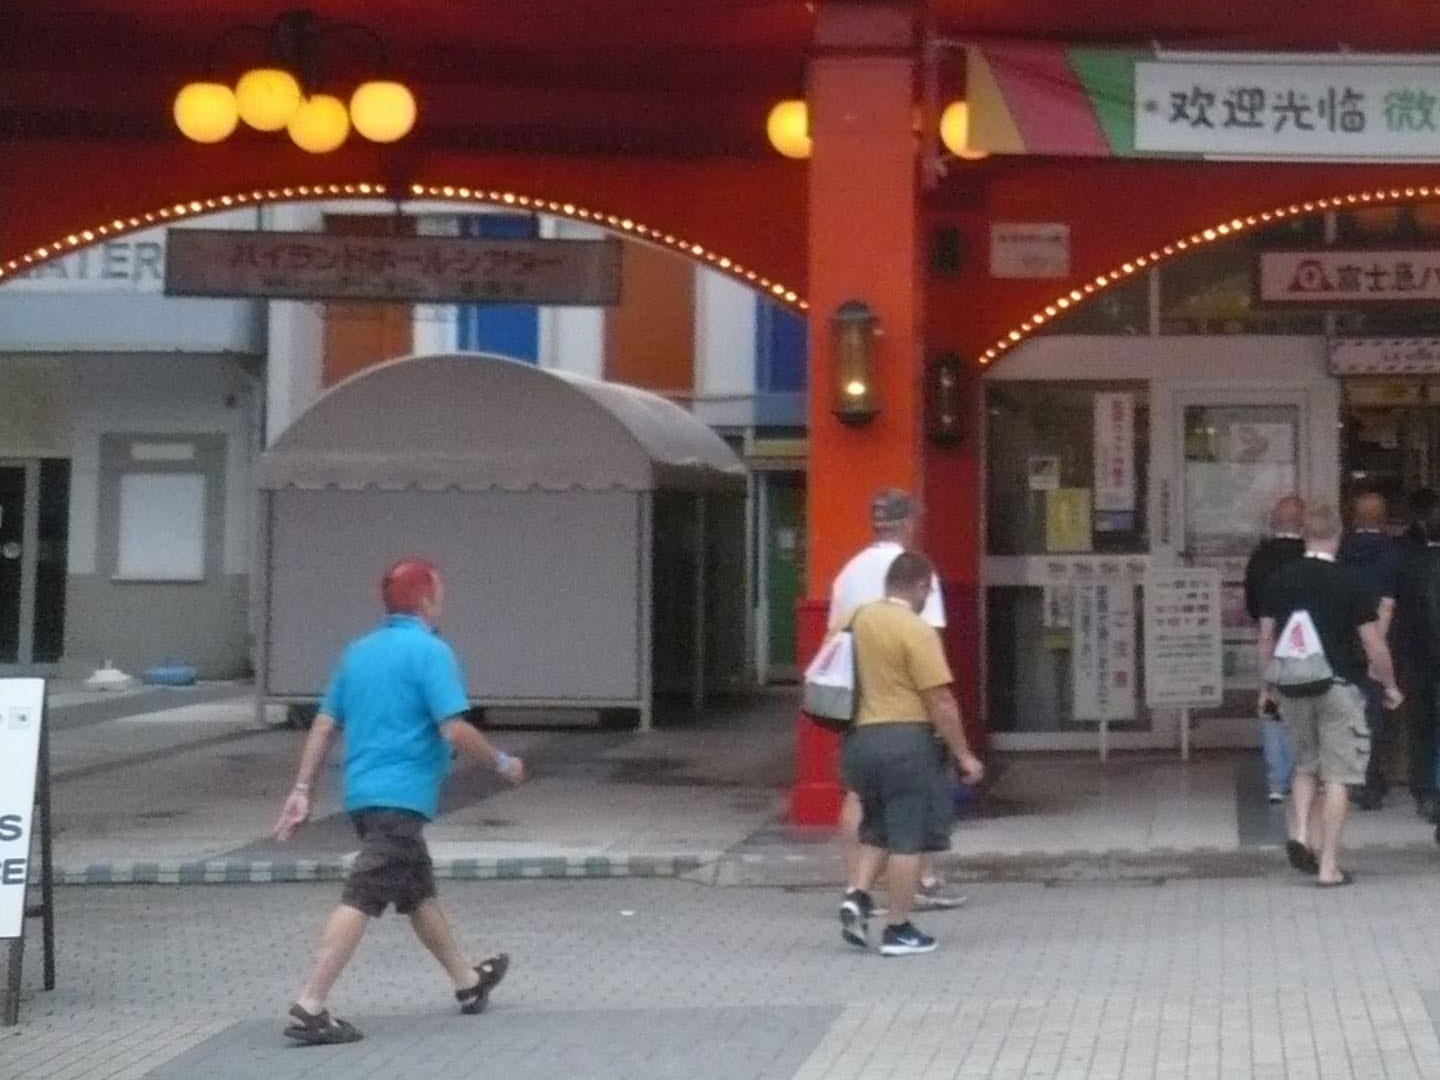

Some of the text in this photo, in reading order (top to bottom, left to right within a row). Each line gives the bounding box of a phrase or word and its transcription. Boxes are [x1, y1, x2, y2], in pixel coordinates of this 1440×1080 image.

[1168, 85, 1366, 133] 欢迎光临
[0, 857, 26, 886] E
